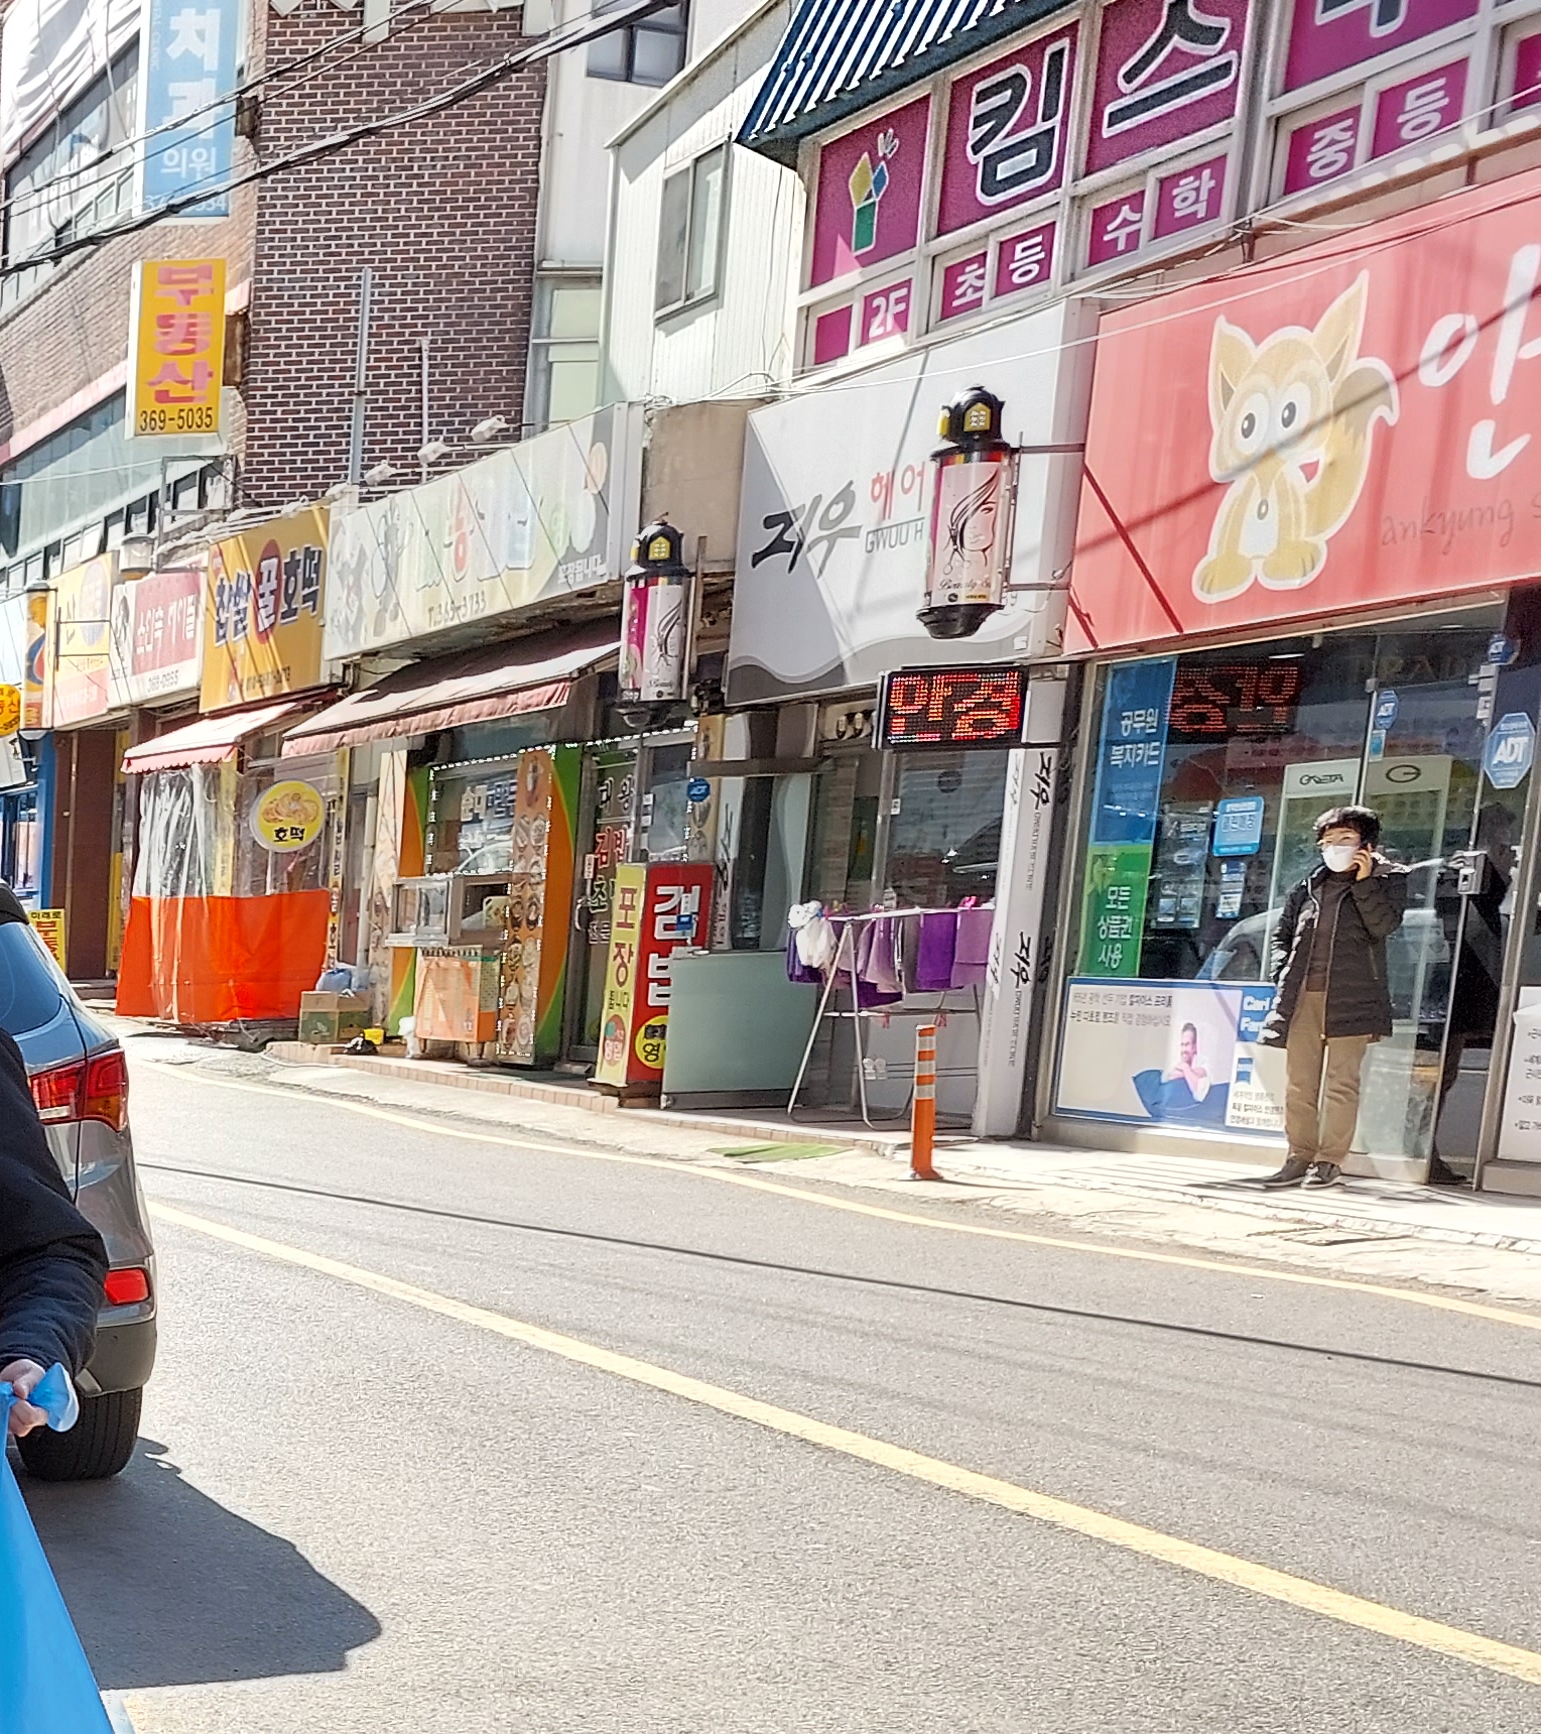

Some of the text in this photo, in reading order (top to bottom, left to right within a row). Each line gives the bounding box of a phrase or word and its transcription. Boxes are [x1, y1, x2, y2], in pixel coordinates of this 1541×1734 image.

[1304, 78, 1450, 179] 중등
[1103, 168, 1217, 252] 수학
[954, 234, 1045, 310] 초등
[869, 286, 910, 339] 2F
[139, 407, 214, 433] 369-5035
[279, 543, 324, 624] 호떡
[889, 668, 1023, 741] 안경
[1120, 706, 1160, 737] 공무원
[1109, 741, 1162, 769] 복지카드
[1492, 736, 1529, 766] ADT
[273, 825, 305, 843] 호떡
[1105, 885, 1132, 910] 모든
[1096, 914, 1133, 940] 상품권
[1098, 943, 1124, 970] 사용
